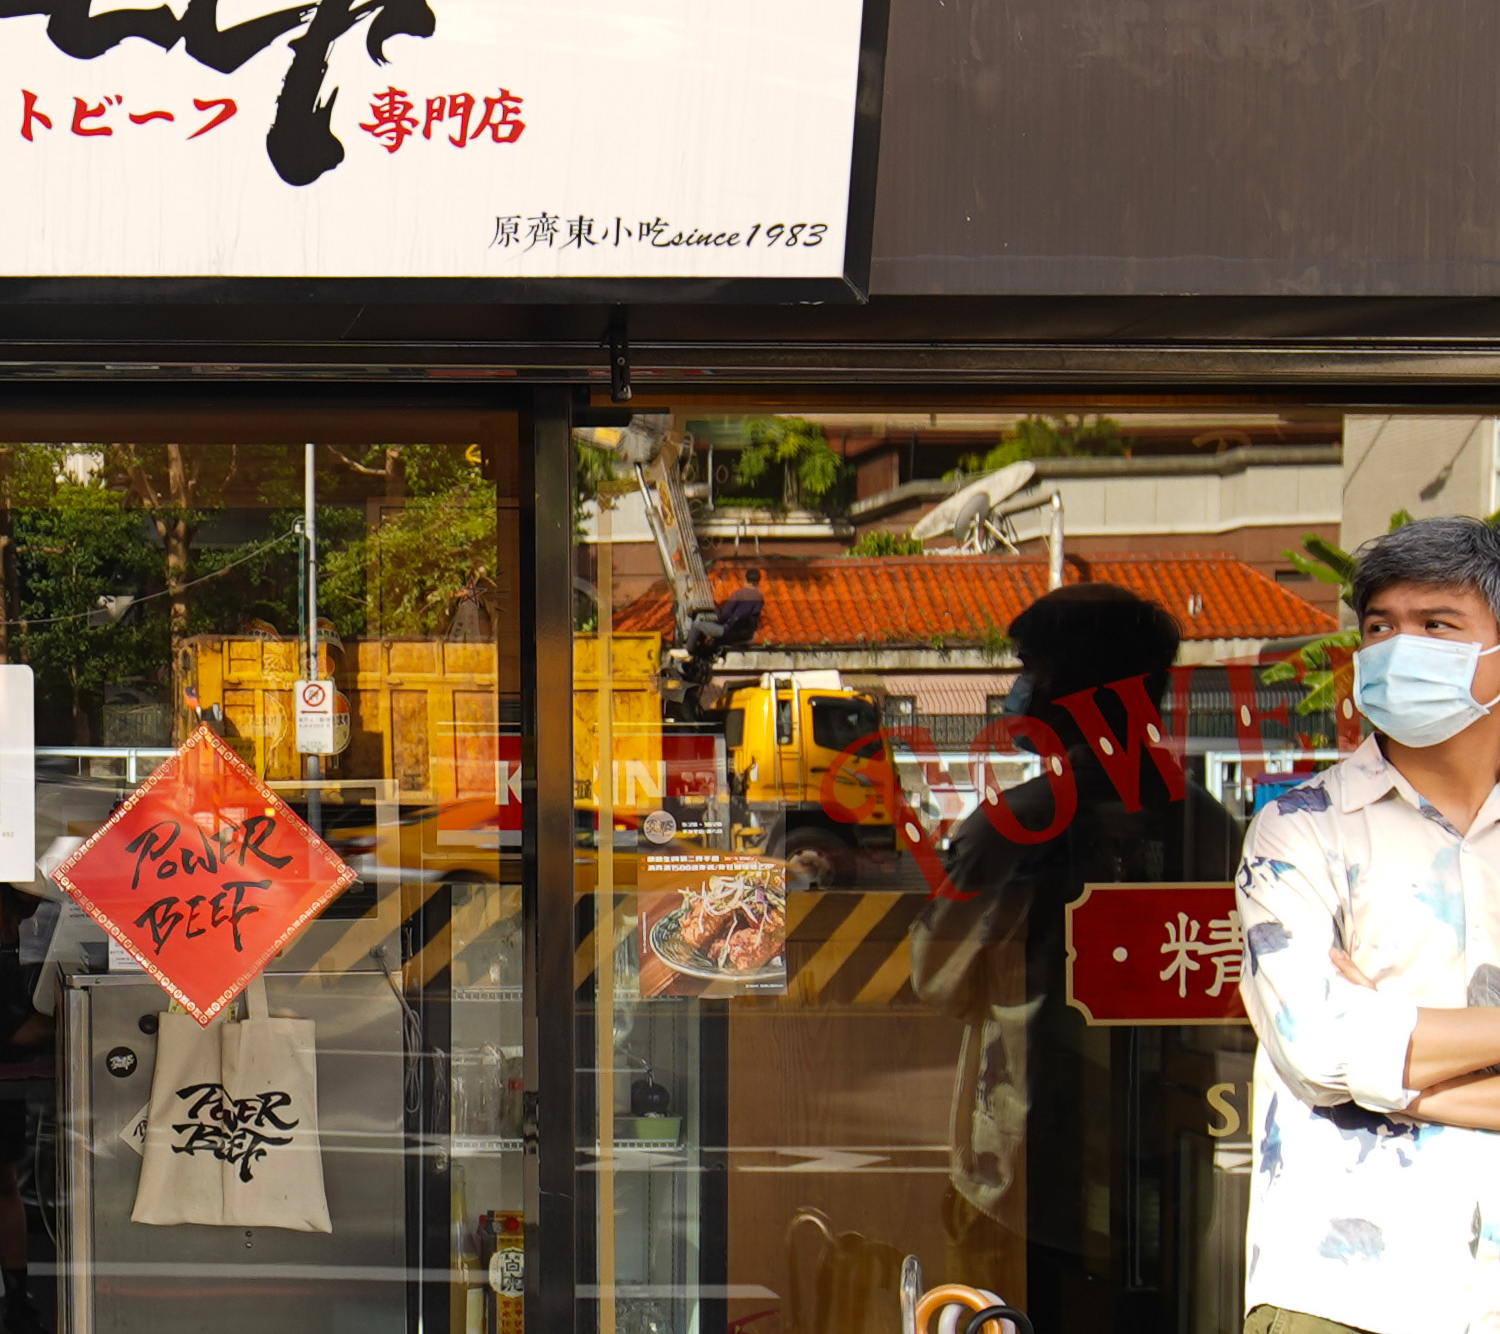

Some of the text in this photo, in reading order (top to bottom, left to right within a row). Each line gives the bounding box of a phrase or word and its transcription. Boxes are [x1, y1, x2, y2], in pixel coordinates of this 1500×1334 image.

[820, 647, 1354, 903] POWE
[125, 815, 293, 890] POWER
[134, 879, 272, 956] BEEF
[175, 1083, 300, 1131] POWER
[171, 1123, 293, 1184] BEEF
